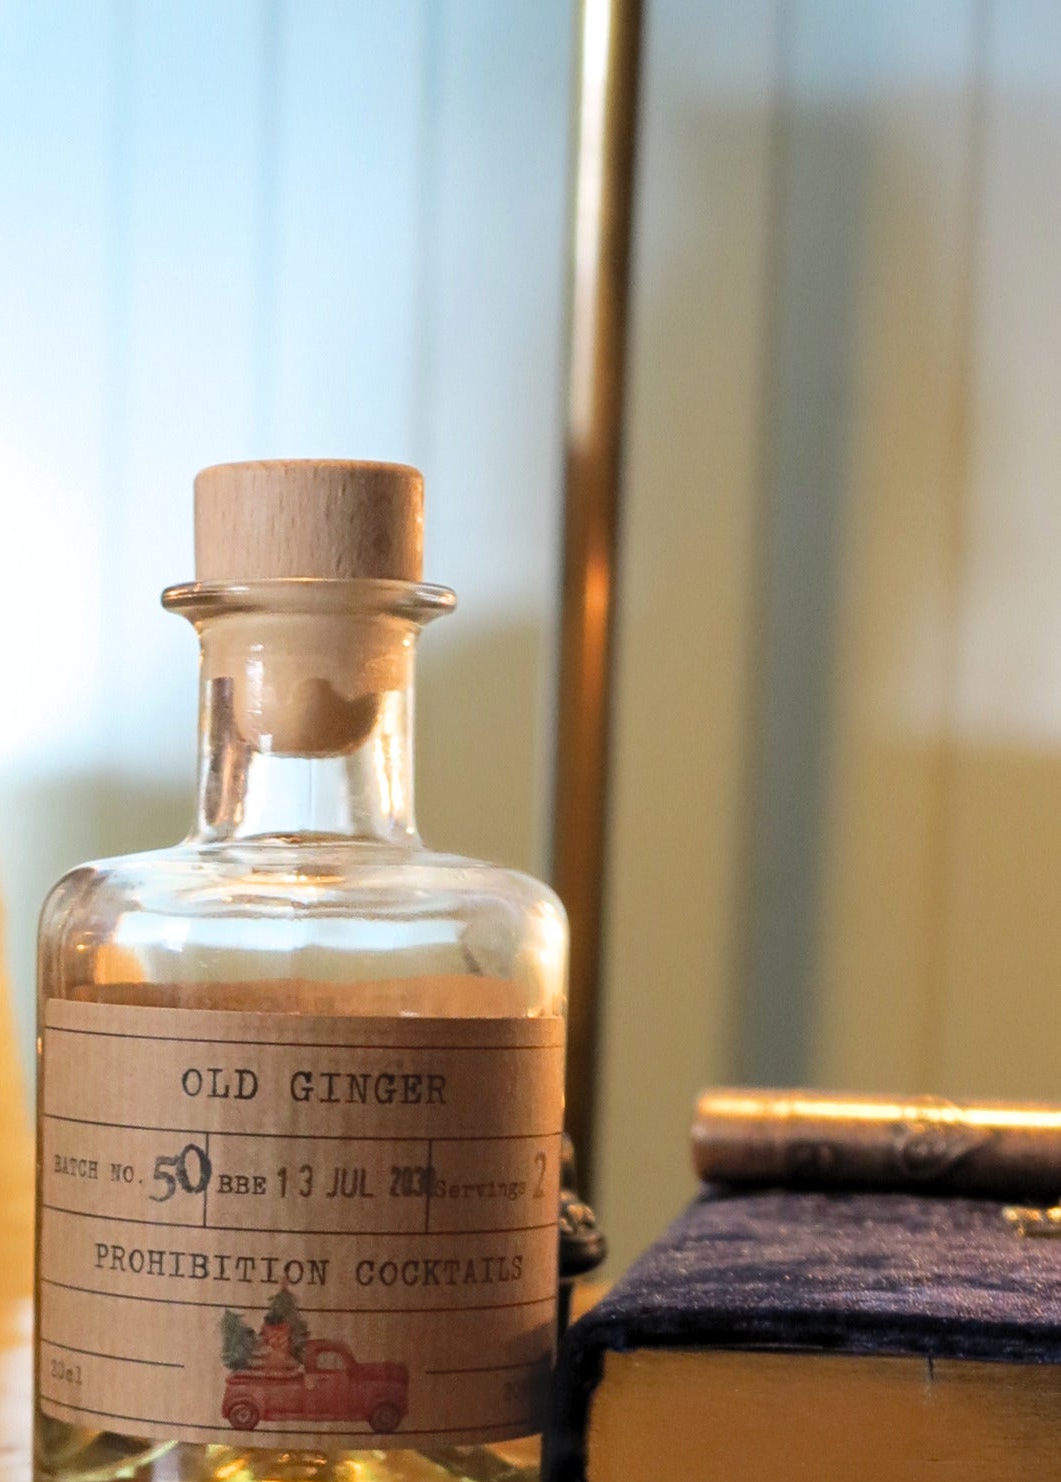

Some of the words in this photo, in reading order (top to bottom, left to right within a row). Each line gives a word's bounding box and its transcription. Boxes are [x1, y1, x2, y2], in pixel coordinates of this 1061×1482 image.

[181, 1067, 259, 1101] OLD
[289, 1070, 447, 1105] GINGER
[53, 1153, 99, 1180] BATCH
[110, 1163, 143, 1185] NO.
[148, 1143, 213, 1203] 50
[216, 1173, 267, 1196] BBE
[325, 1166, 375, 1200] JUL
[437, 1179, 528, 1202] Servings
[532, 1150, 548, 1200] 2
[94, 1242, 329, 1287] PROHIBITION
[355, 1254, 524, 1287] COCKTAILS
